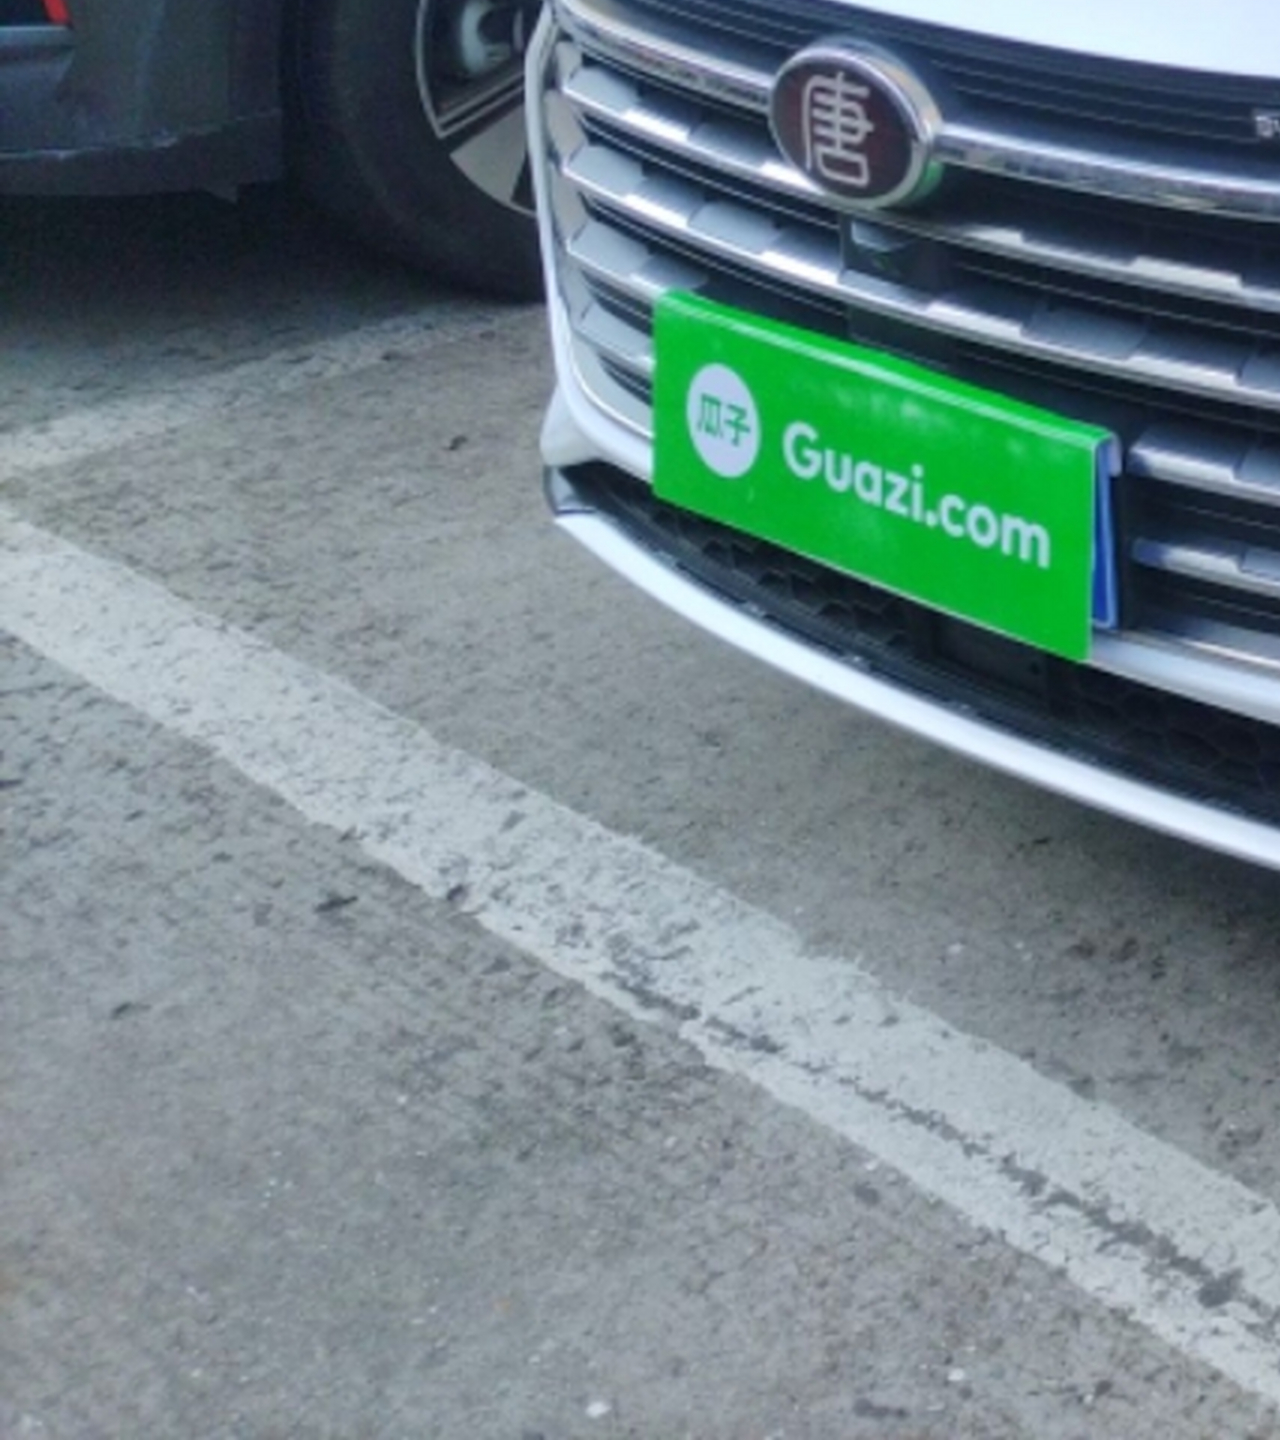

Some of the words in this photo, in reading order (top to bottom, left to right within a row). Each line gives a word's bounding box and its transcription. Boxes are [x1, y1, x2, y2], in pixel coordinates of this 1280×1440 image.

[802, 71, 874, 188] 唐
[697, 392, 752, 448] 瓜子
[781, 421, 1052, 570] Guazi.com
